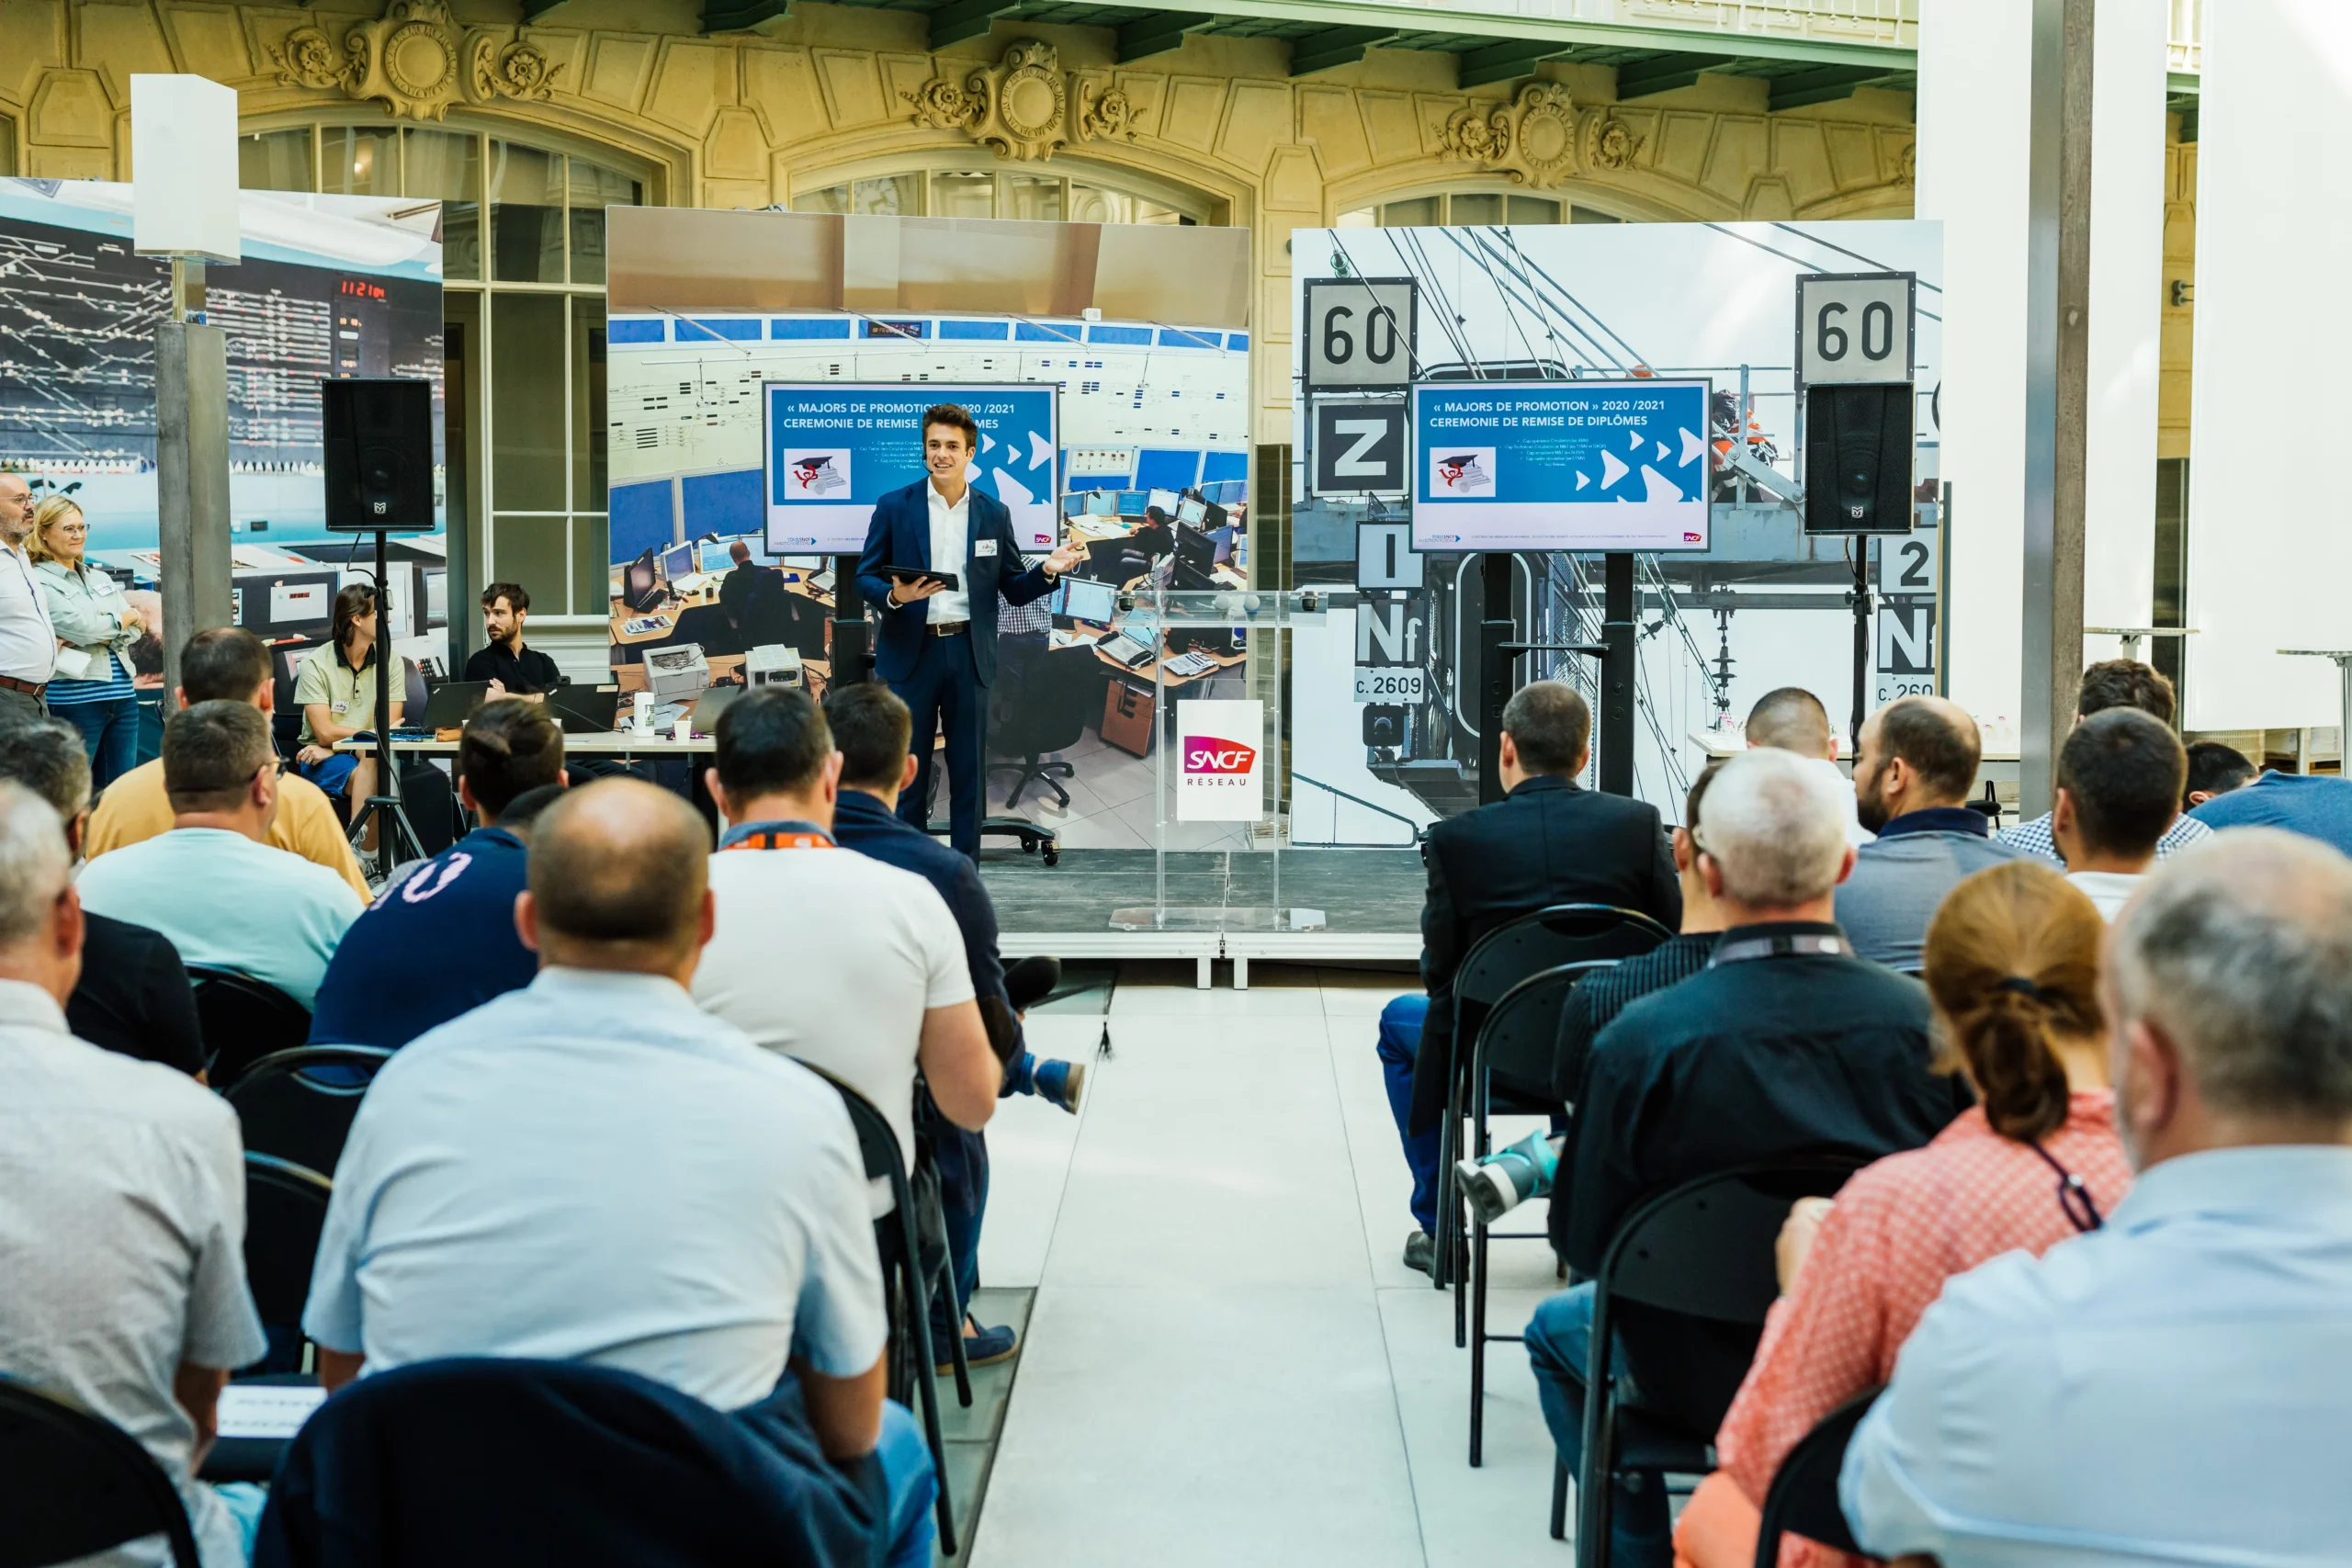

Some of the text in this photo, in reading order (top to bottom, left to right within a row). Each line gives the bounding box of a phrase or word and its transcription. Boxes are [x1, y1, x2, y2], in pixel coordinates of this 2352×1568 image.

[1324, 306, 1396, 365] 60
[1817, 300, 1894, 362] 60
[798, 403, 847, 413] MAJORS
[851, 403, 866, 413] DE
[870, 403, 941, 413] PROMOTIO
[1445, 402, 1493, 412] MAJORS
[1497, 401, 1512, 412] DE
[1516, 401, 1589, 412] PROMOTION
[1602, 400, 1630, 411] 2020
[784, 418, 919, 429] CEREMONIE DE REMISE
[1430, 413, 1647, 427] CEREMONIE DE REMISE DE DIPLÔMES
[1335, 419, 1387, 477] Z
[1900, 541, 1929, 587] 2
[1357, 604, 1423, 662] Nf
[1186, 750, 1251, 770] SNCF
[1187, 777, 1247, 786] RÉSEAU
